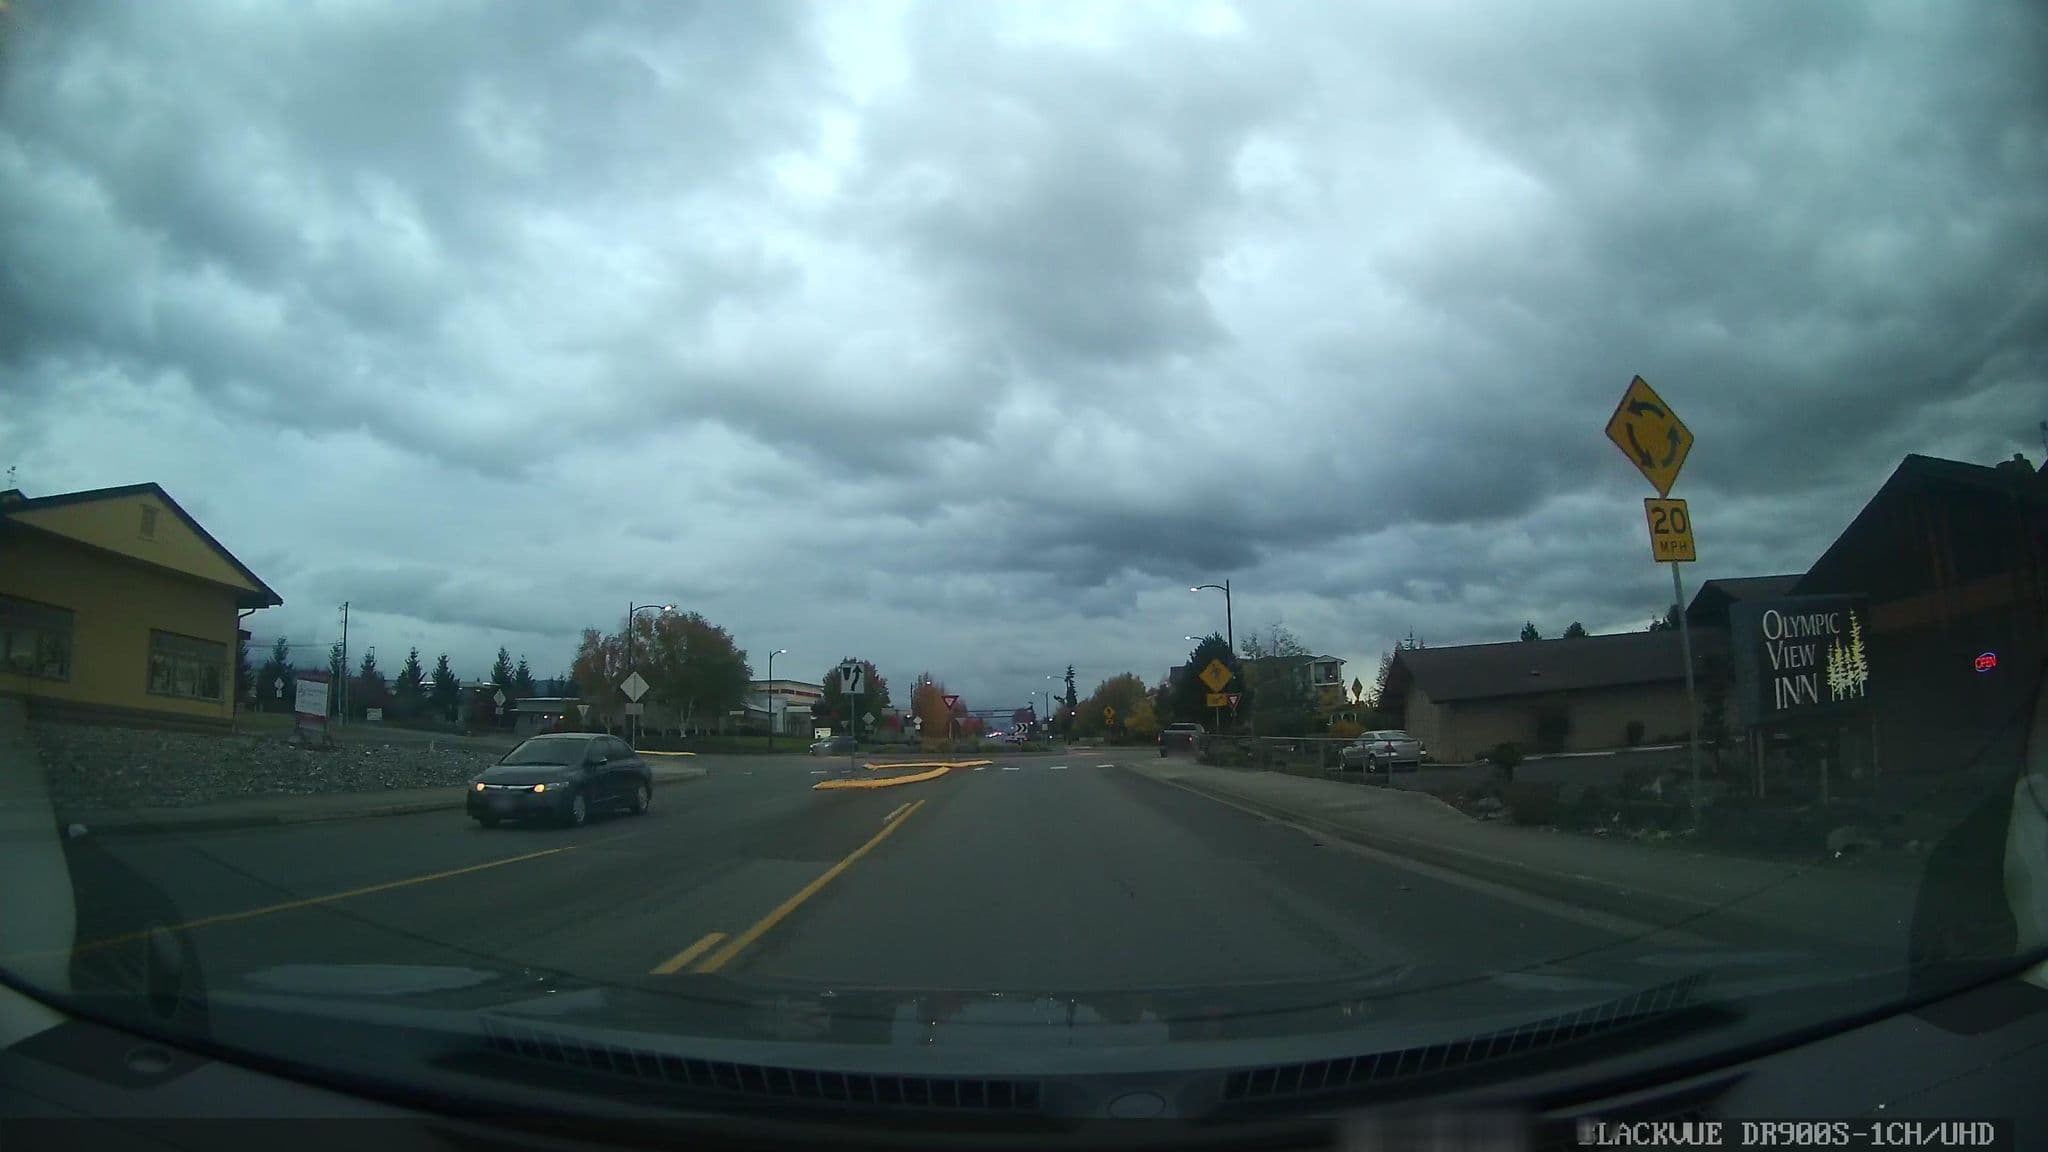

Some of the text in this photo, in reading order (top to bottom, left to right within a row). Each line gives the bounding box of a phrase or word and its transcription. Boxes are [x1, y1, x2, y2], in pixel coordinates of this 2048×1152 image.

[1651, 507, 1686, 534] 20
[1660, 540, 1688, 554] MPH
[1762, 609, 1841, 640] OLYMPIC
[1766, 640, 1816, 671] VIEW
[1974, 655, 1997, 669] OPEN
[1774, 672, 1819, 710] INN
